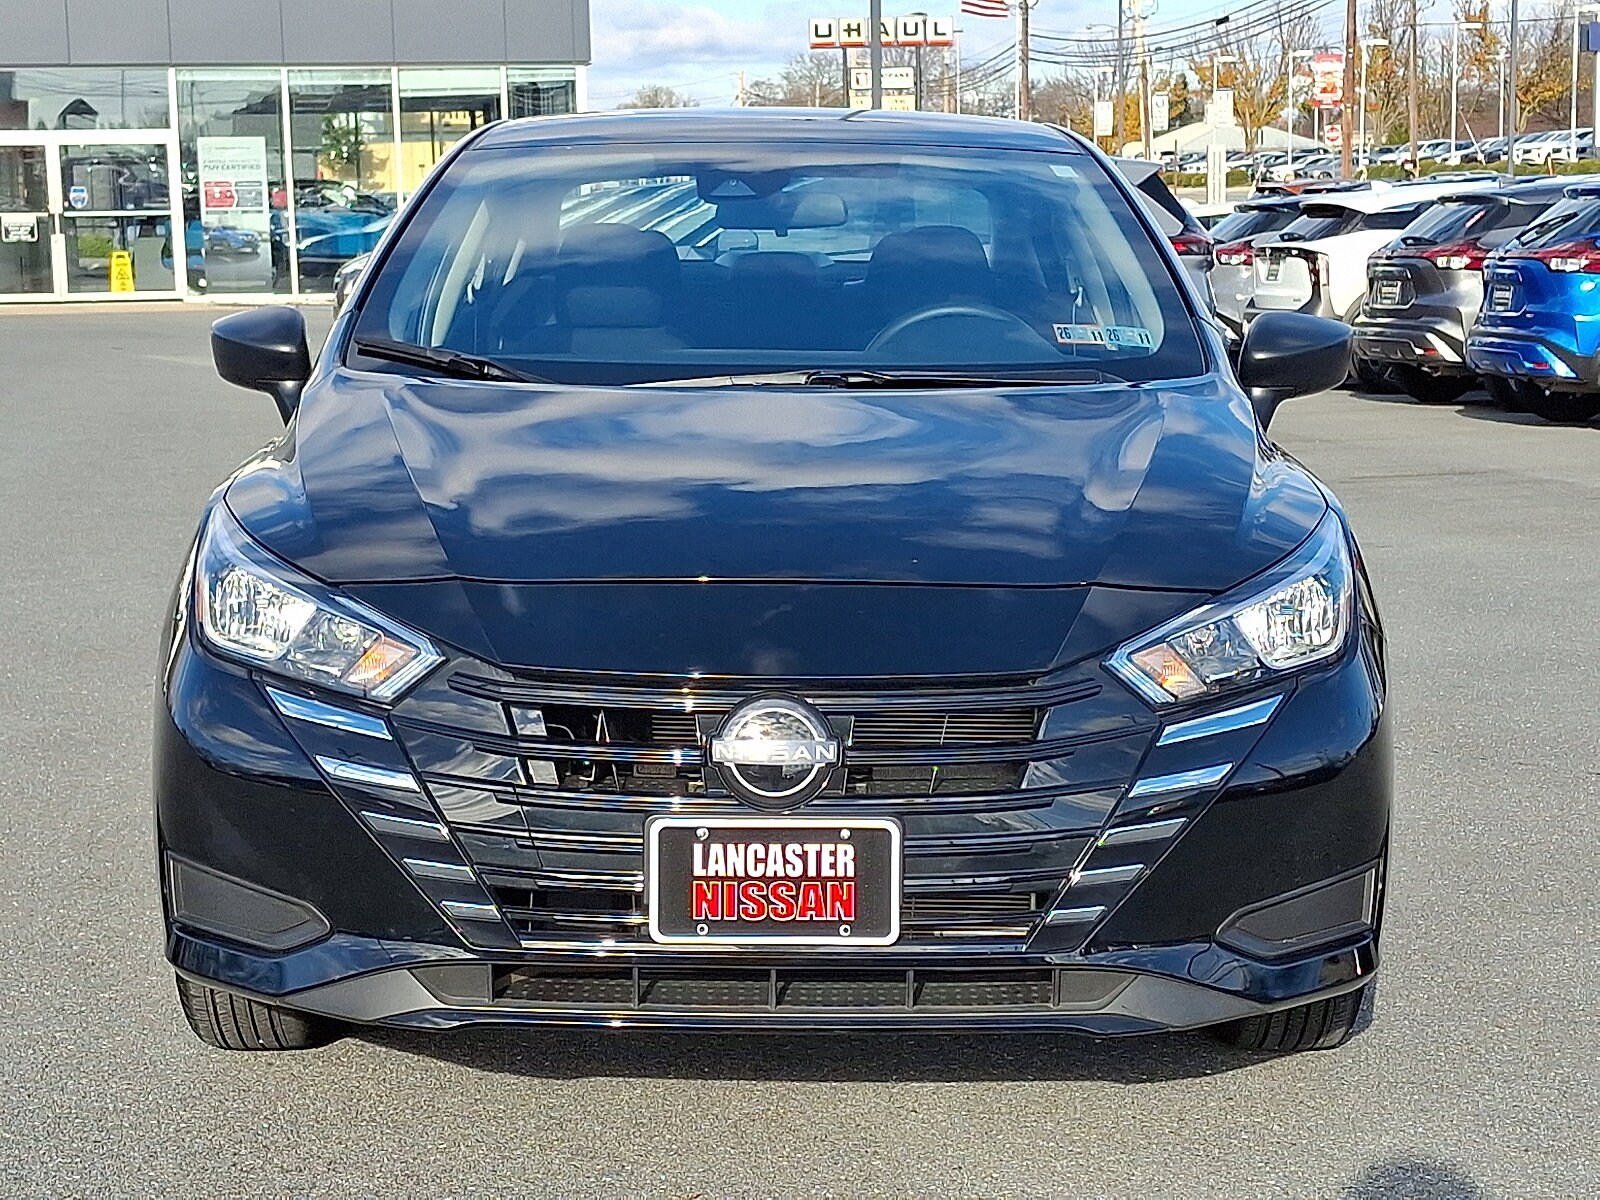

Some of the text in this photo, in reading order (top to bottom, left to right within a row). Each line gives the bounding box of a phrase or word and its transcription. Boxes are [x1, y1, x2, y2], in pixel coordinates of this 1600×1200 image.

[1057, 327, 1104, 342] 26 11
[1106, 328, 1151, 344] 26 11
[715, 743, 835, 761] NSAN
[692, 843, 855, 877] LANCASTER
[692, 881, 855, 921] NISSAN
